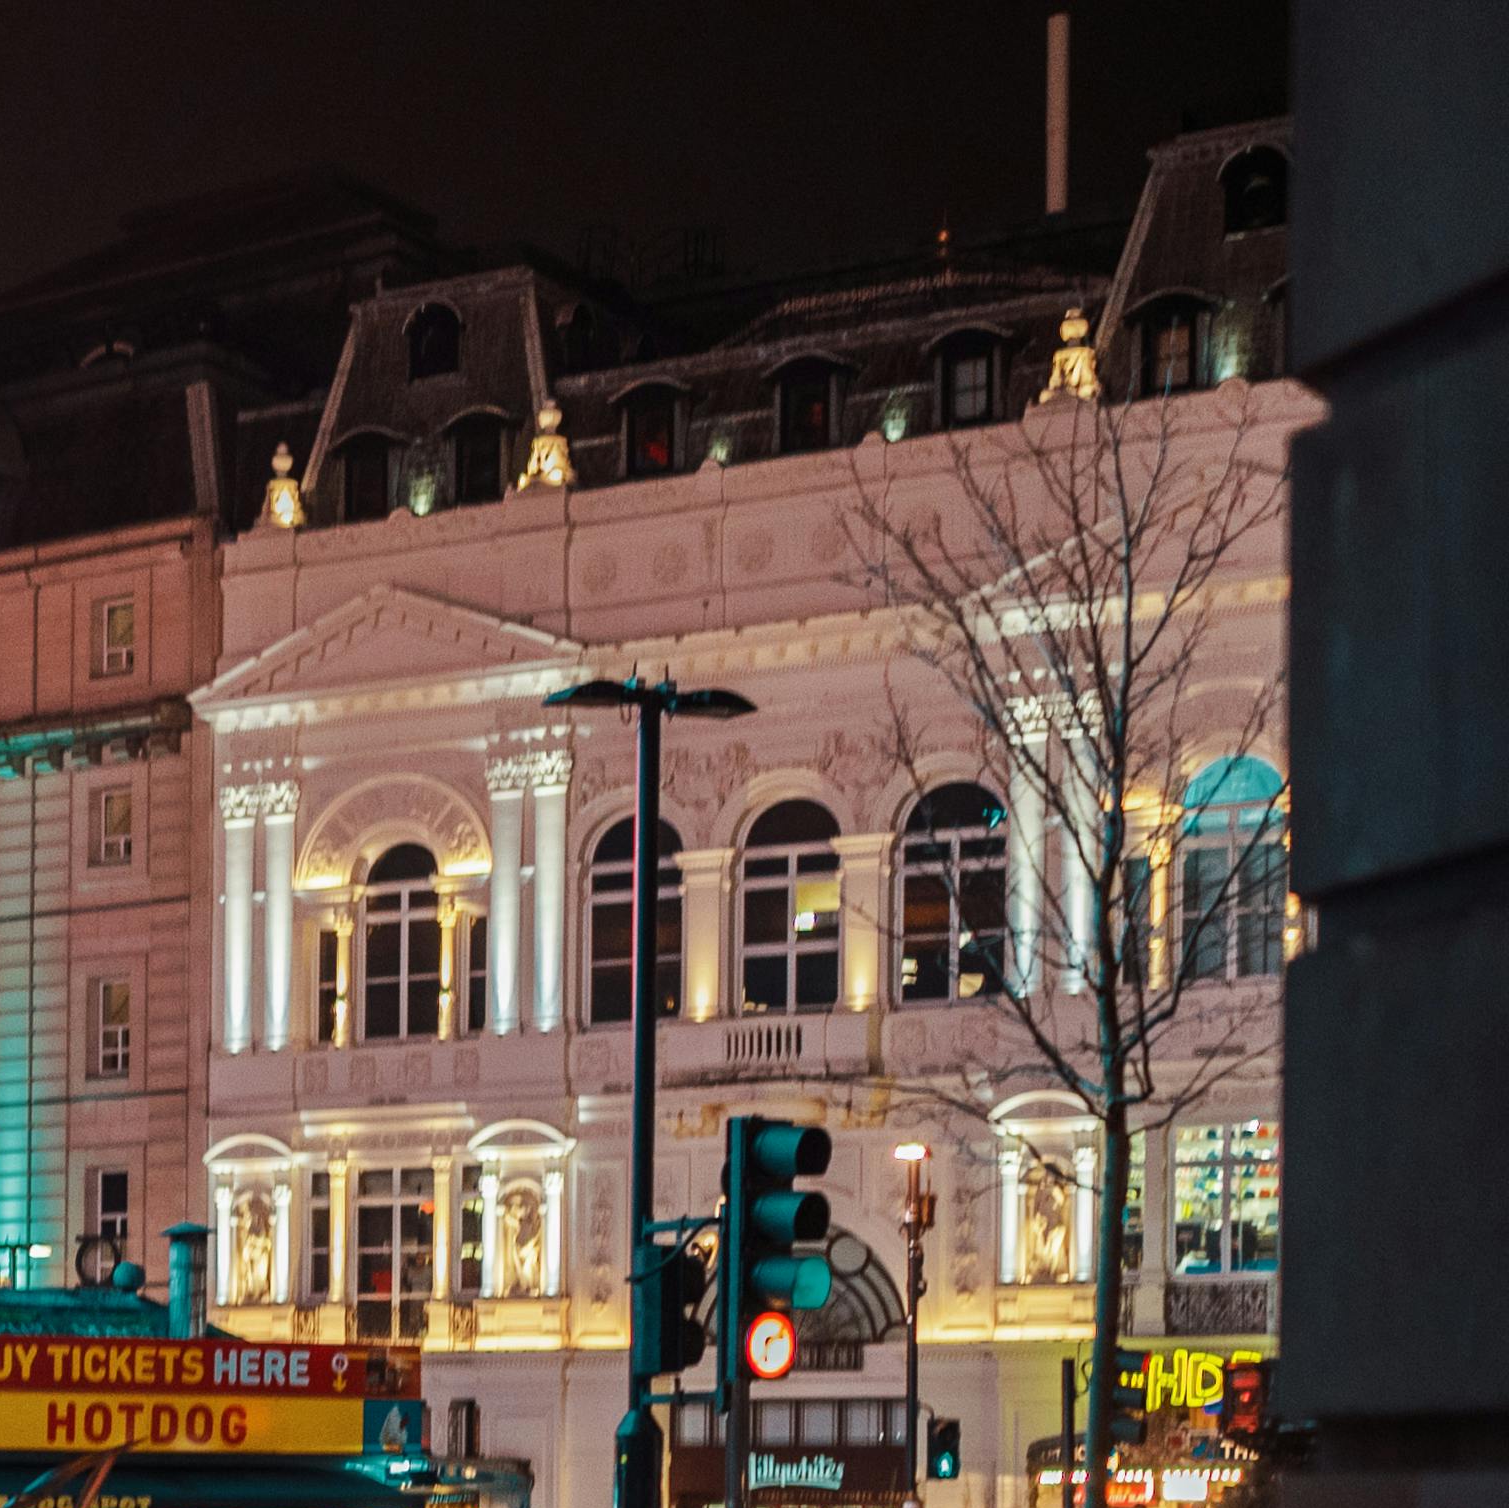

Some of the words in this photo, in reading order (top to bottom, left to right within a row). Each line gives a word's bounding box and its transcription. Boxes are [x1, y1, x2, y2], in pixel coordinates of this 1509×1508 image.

[46, 1344, 205, 1384] TICKETS
[213, 1348, 311, 1387] HERE
[45, 1400, 249, 1447] HOTDOG
